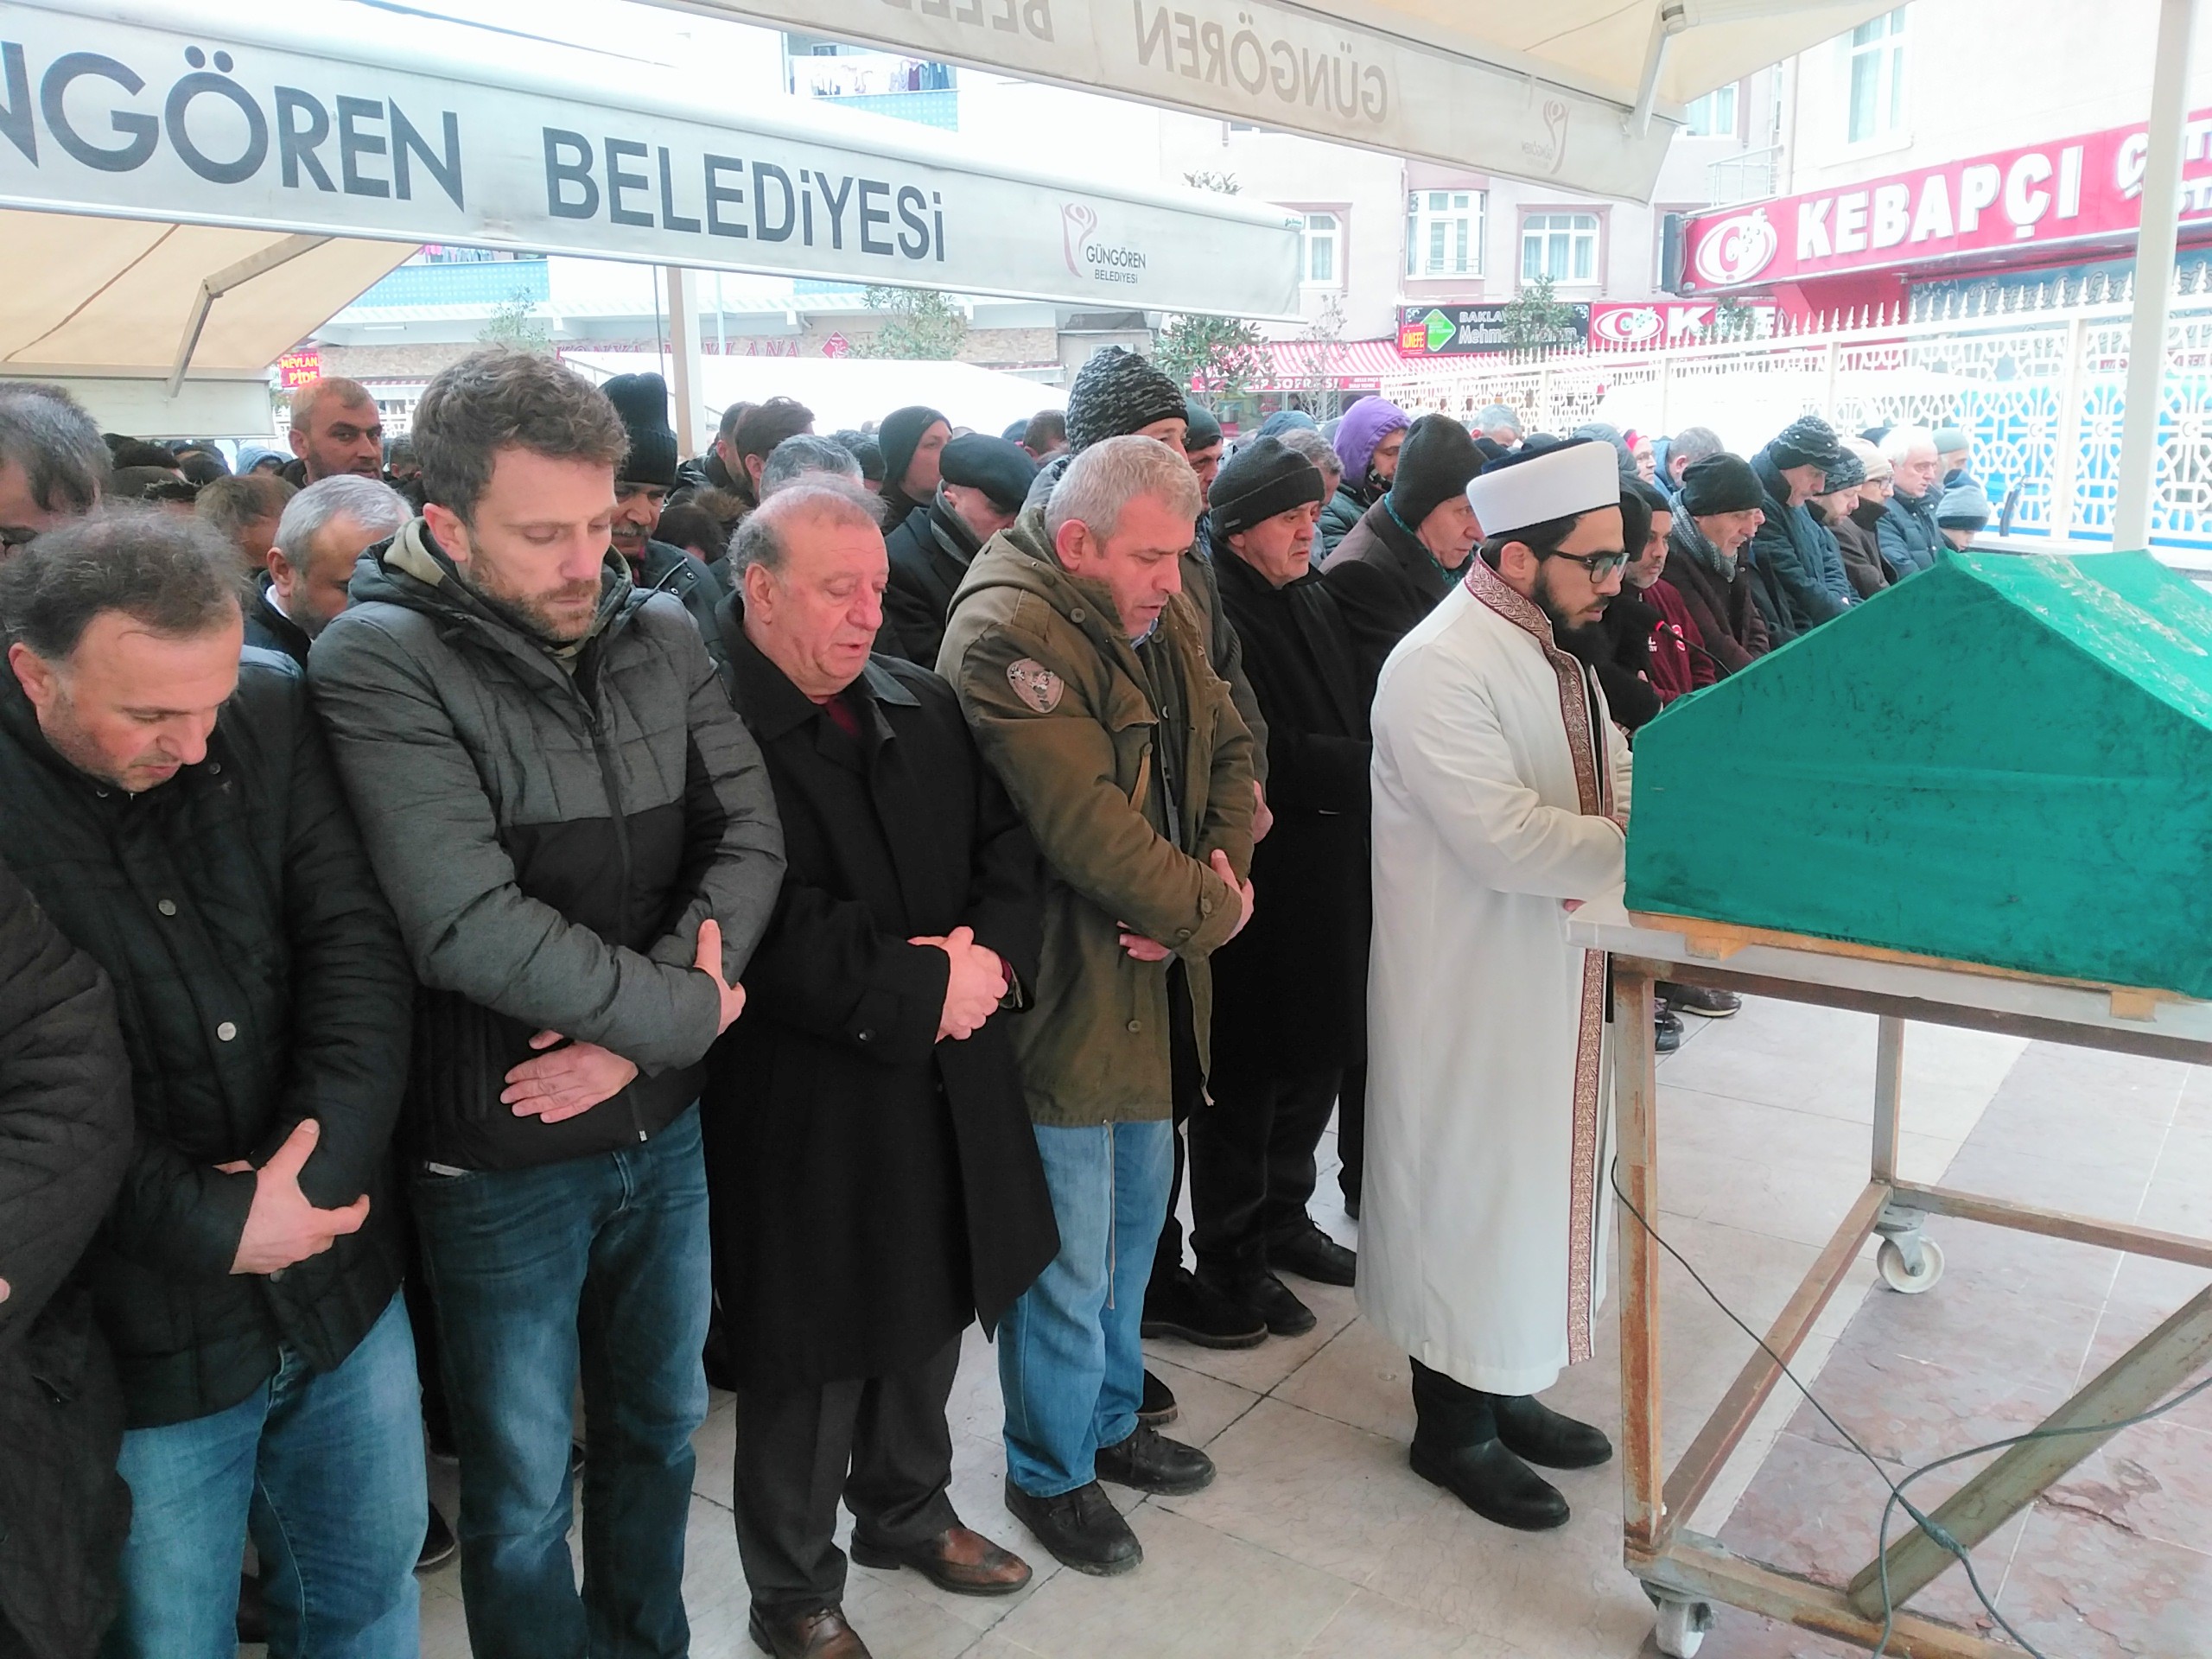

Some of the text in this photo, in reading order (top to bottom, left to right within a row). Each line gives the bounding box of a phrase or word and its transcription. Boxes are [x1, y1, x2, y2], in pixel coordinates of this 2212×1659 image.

[1797, 145, 2083, 260] KEBAPÇI
[1086, 244, 1146, 269] GÜNGÖREN
[1402, 329, 1424, 348] KÜNEFE
[281, 357, 319, 368] MEVLAN
[1274, 378, 1338, 390] SOFRSI
